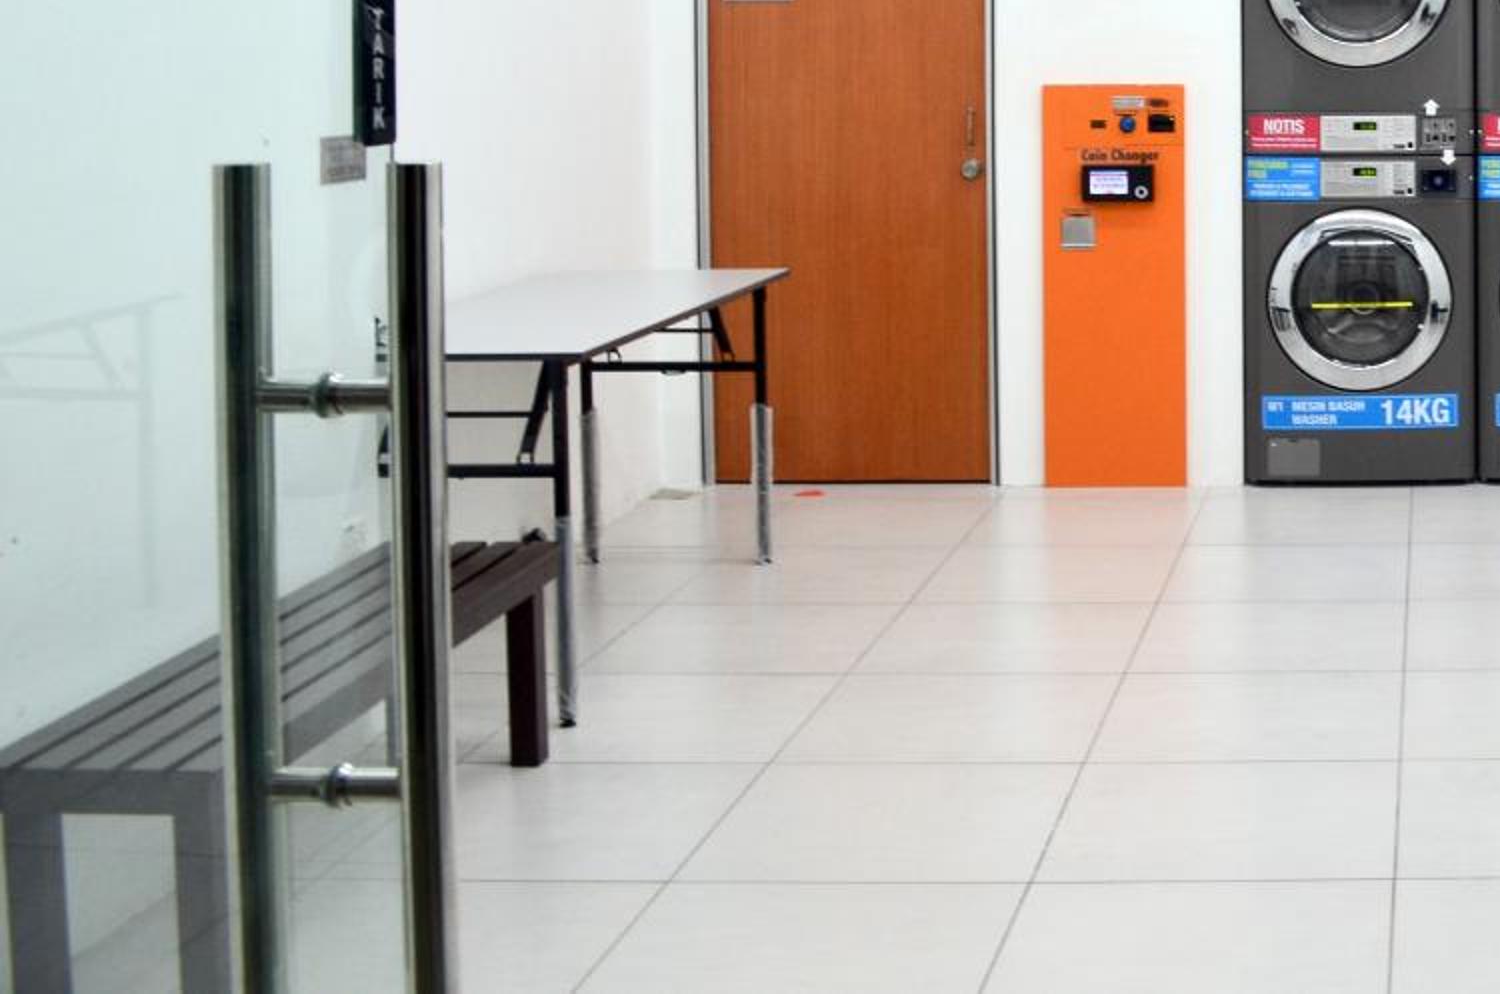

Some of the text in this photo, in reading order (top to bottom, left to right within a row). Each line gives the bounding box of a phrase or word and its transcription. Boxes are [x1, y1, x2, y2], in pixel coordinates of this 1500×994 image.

[372, 8, 385, 130] TARIK
[1263, 118, 1305, 135] NOTIS
[1081, 149, 1159, 163] Coin Changer
[1291, 401, 1326, 412] MESIN
[1381, 398, 1450, 425] 14KG
[1291, 414, 1338, 425] WASHER
